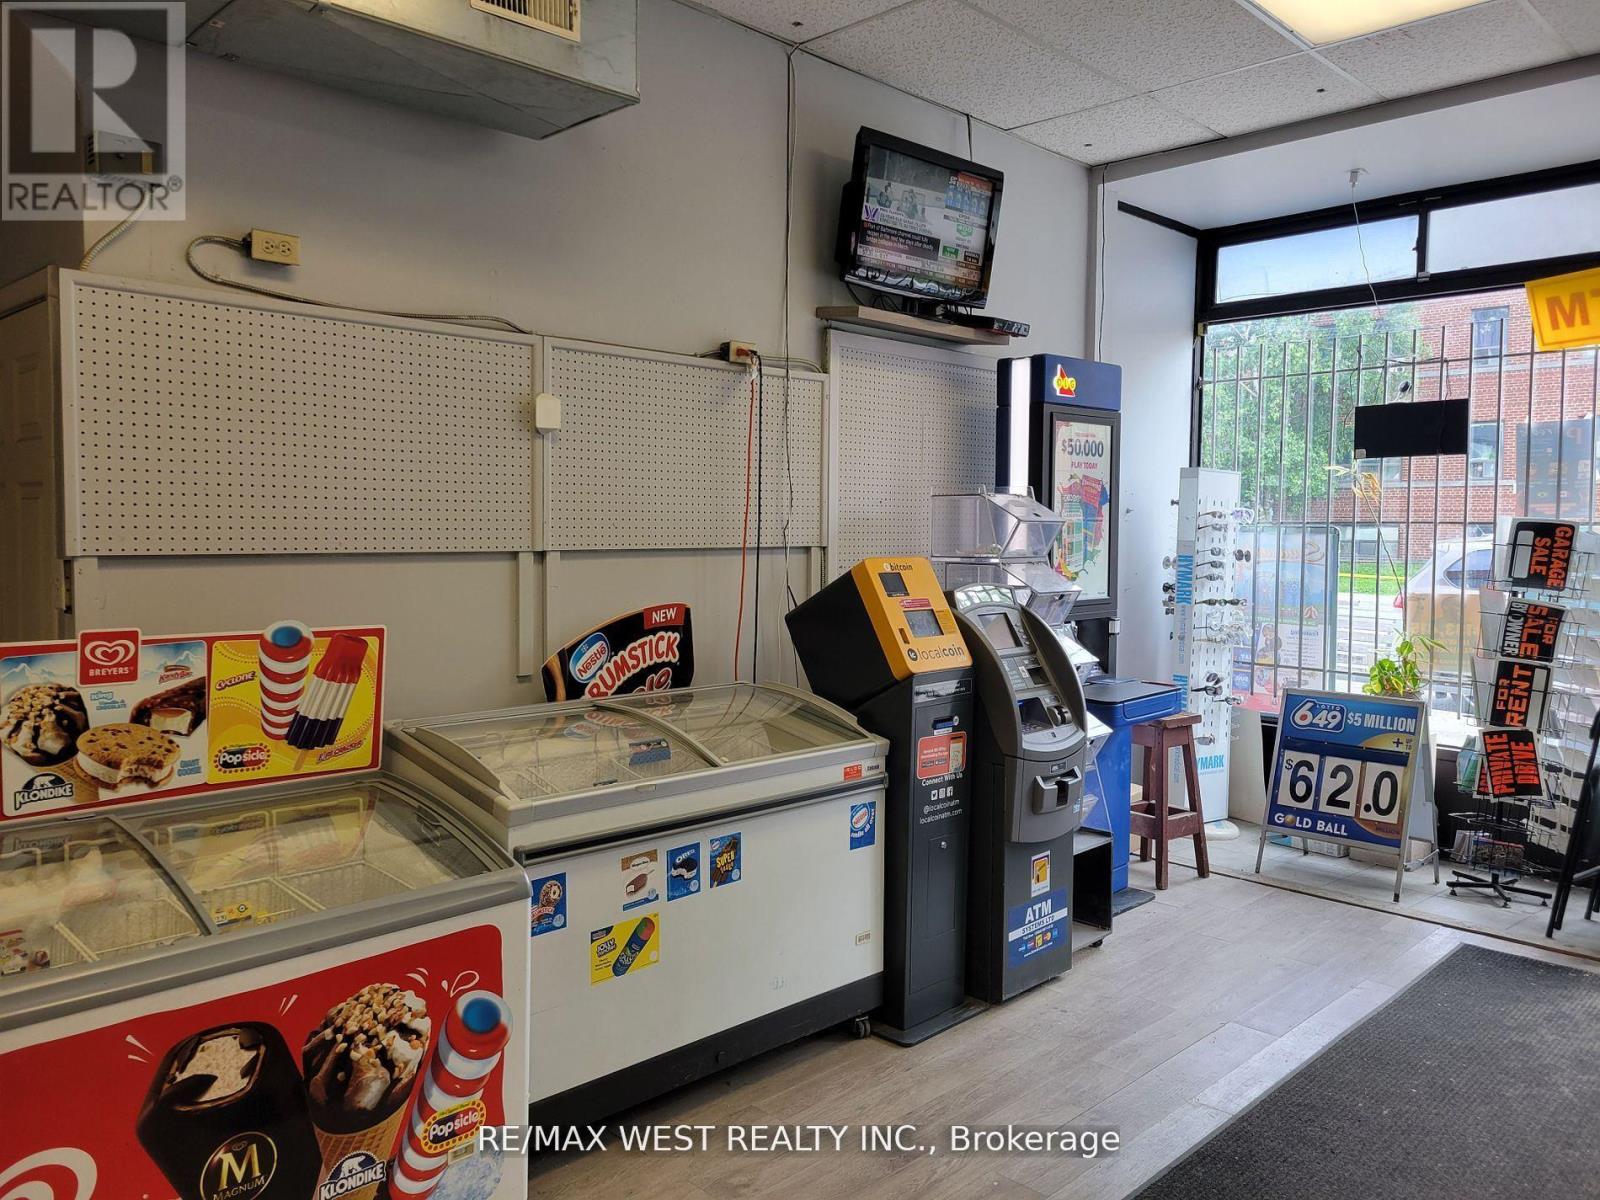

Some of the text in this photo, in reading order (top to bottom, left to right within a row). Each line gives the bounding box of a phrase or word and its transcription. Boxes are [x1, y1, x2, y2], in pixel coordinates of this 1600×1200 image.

[891, 563, 913, 572] bitcoin
[1530, 537, 1551, 575] SALE
[1546, 526, 1573, 587] GARAGE
[1176, 554, 1194, 606] HYMARK
[652, 607, 677, 624] NEW
[1519, 603, 1549, 658] SALE
[1503, 614, 1526, 656] OWNER
[577, 643, 607, 678] Nestlé
[586, 634, 681, 698] RUMSTICK
[918, 644, 965, 661] localcoin
[88, 667, 130, 677] BREYERS
[1496, 678, 1511, 710] FOR
[1505, 664, 1532, 727] RENT
[1294, 702, 1342, 729] 649
[1347, 713, 1416, 733] $5 MILLION
[1510, 741, 1540, 785] DRIVE
[921, 776, 945, 787] Connect
[14, 784, 73, 810] KLONDIKE
[1316, 820, 1348, 836] BALL
[1025, 899, 1052, 924] ATM
[429, 1111, 479, 1141] Popsicle
[213, 1176, 266, 1200] MAGNUM
[320, 1162, 385, 1200] KLONDIKE
